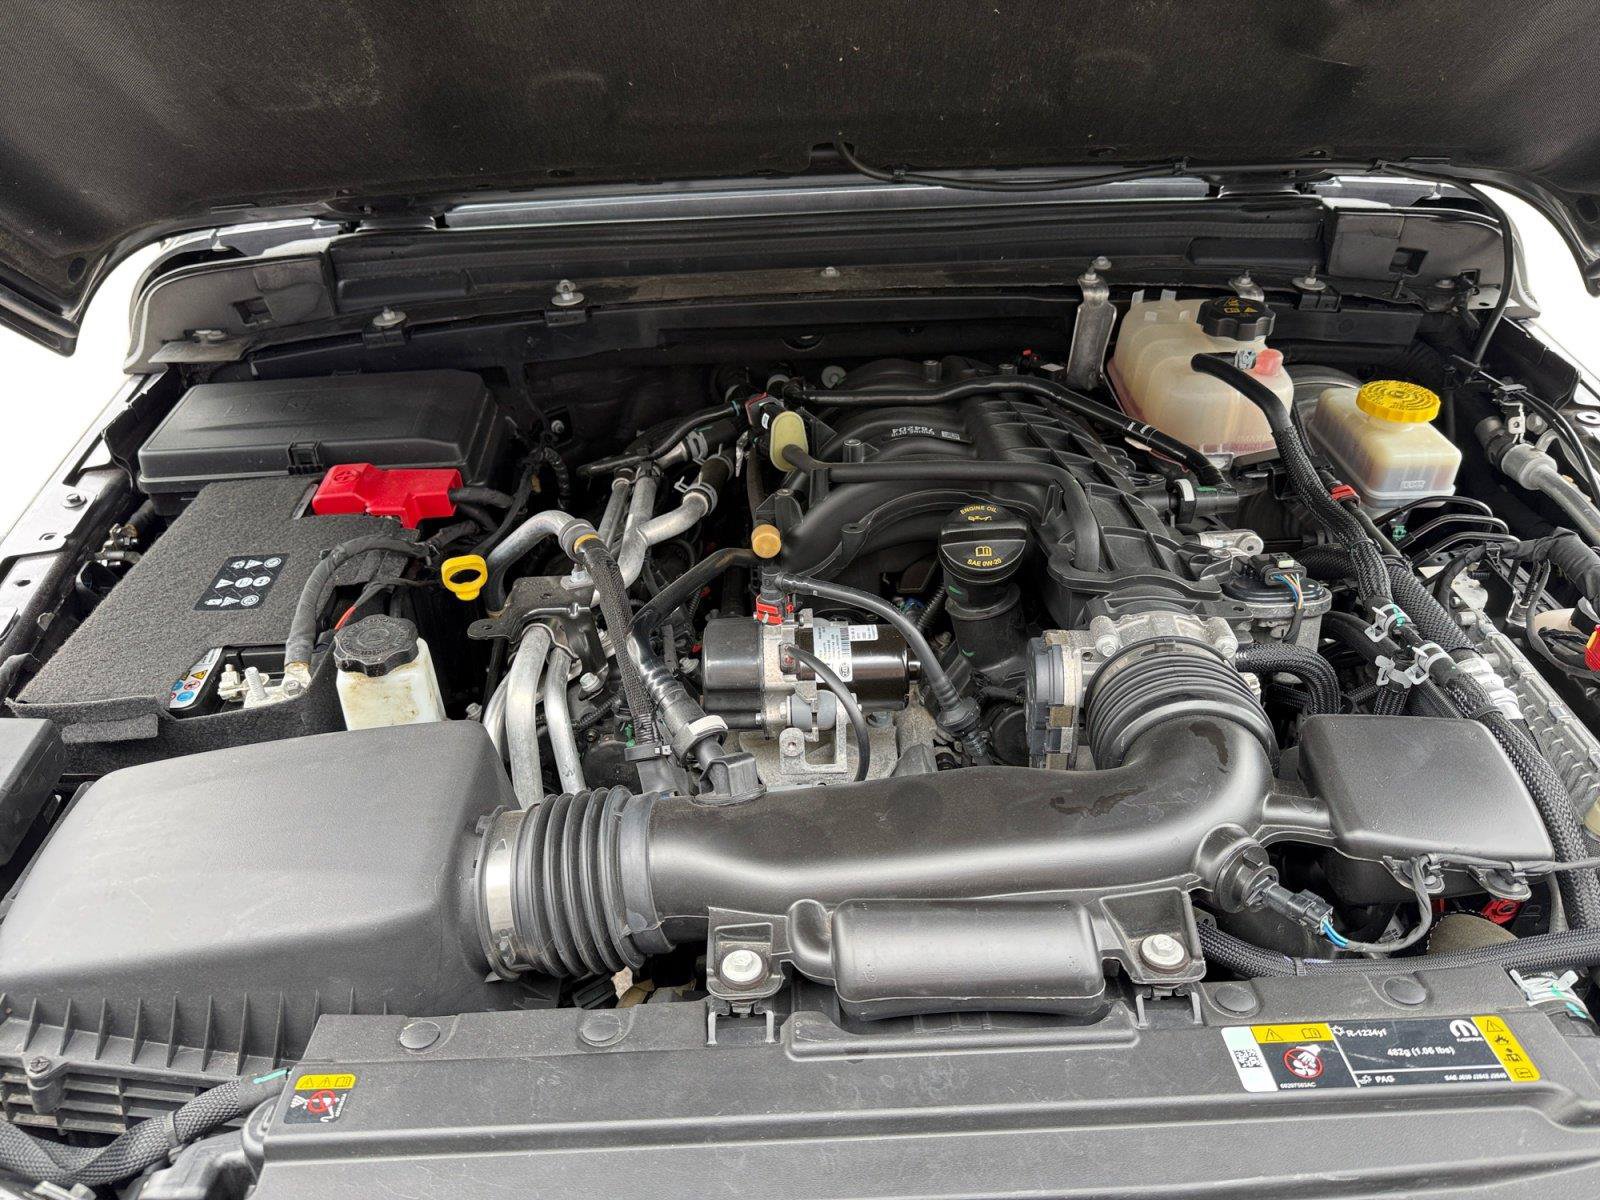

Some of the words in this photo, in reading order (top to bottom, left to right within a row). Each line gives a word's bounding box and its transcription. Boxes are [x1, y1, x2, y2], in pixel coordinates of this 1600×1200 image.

[960, 505, 985, 515] ENGINE
[986, 505, 998, 513] OIL
[967, 559, 981, 567] SAE
[982, 557, 1002, 567] 0W-20
[1346, 1028, 1387, 1037] R-1234yf
[1387, 1048, 1411, 1057] 482g
[1435, 1046, 1455, 1055] lbs)
[1375, 1075, 1395, 1083] PAG
